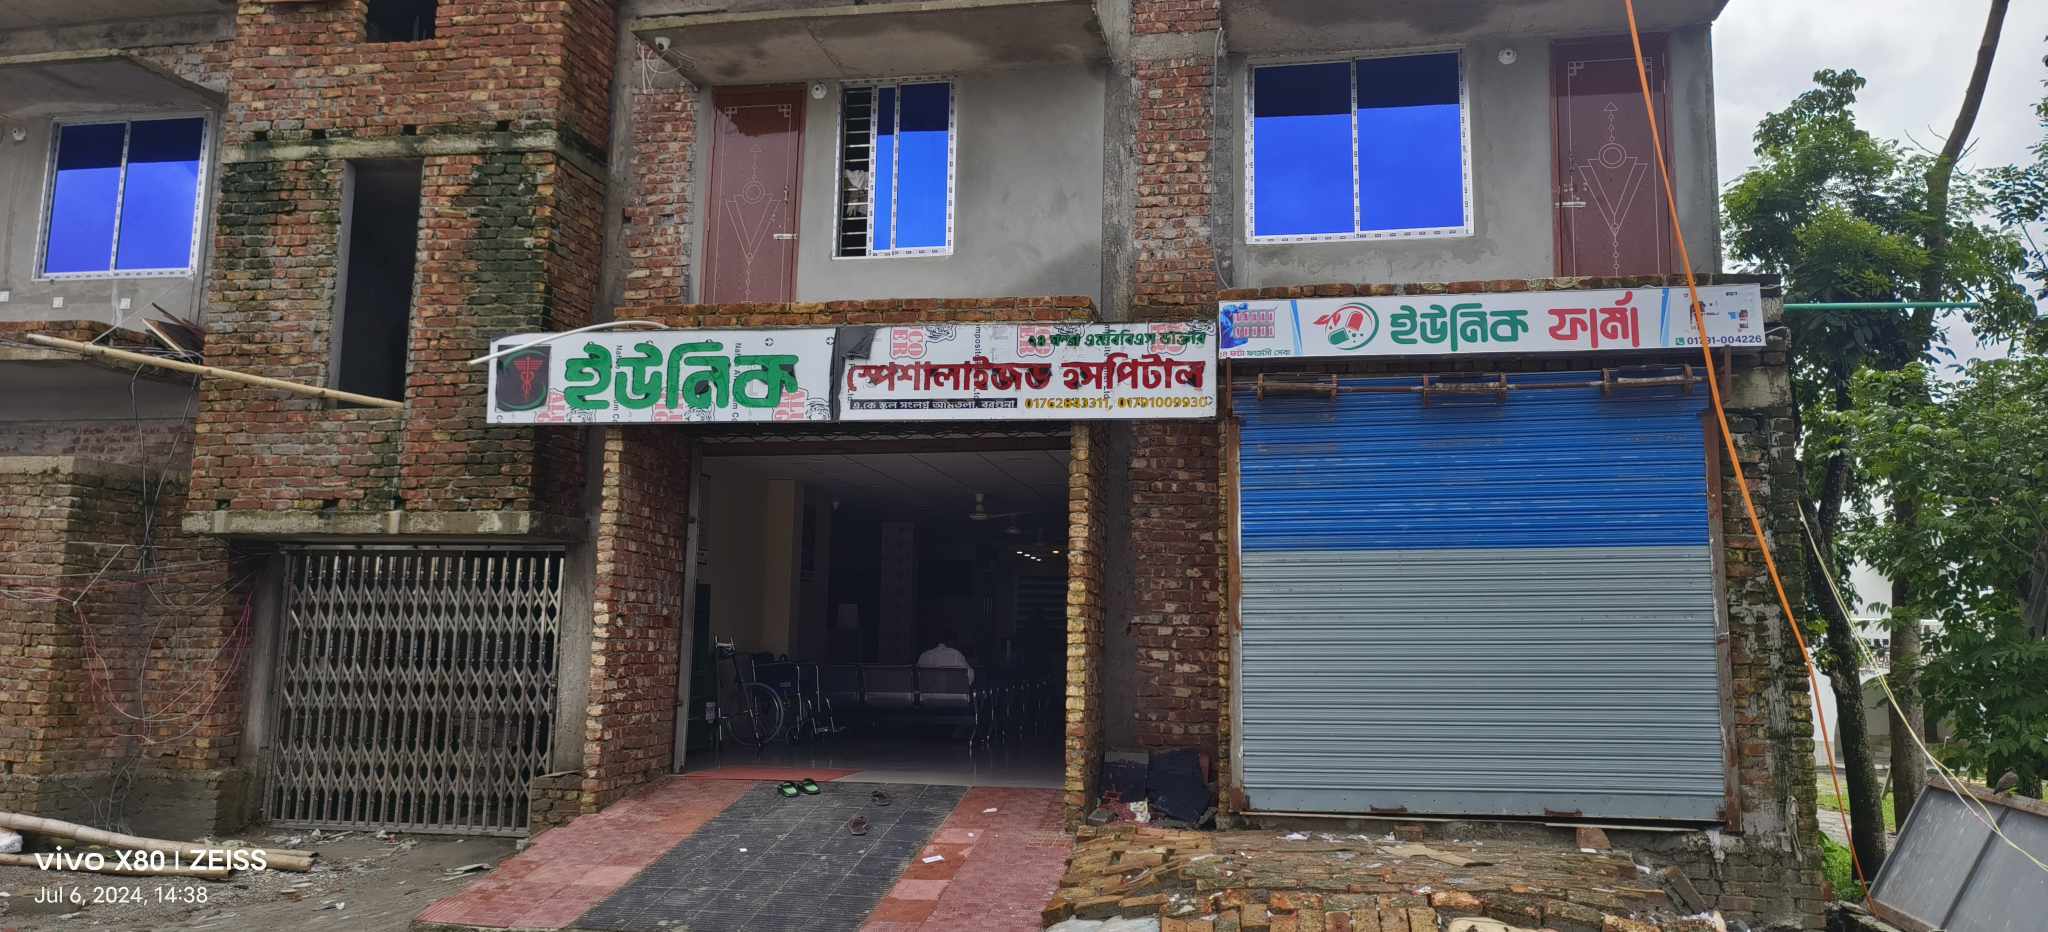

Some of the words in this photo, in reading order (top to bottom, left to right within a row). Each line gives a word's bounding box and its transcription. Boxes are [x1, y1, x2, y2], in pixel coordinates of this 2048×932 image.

[1084, 329, 1155, 346] এমবিবিএস
[1390, 302, 1529, 352] ইউনিক
[1547, 291, 1641, 349] ফার্মা
[564, 341, 800, 410] ইউনিক
[1062, 353, 1207, 392] হসপিটাল
